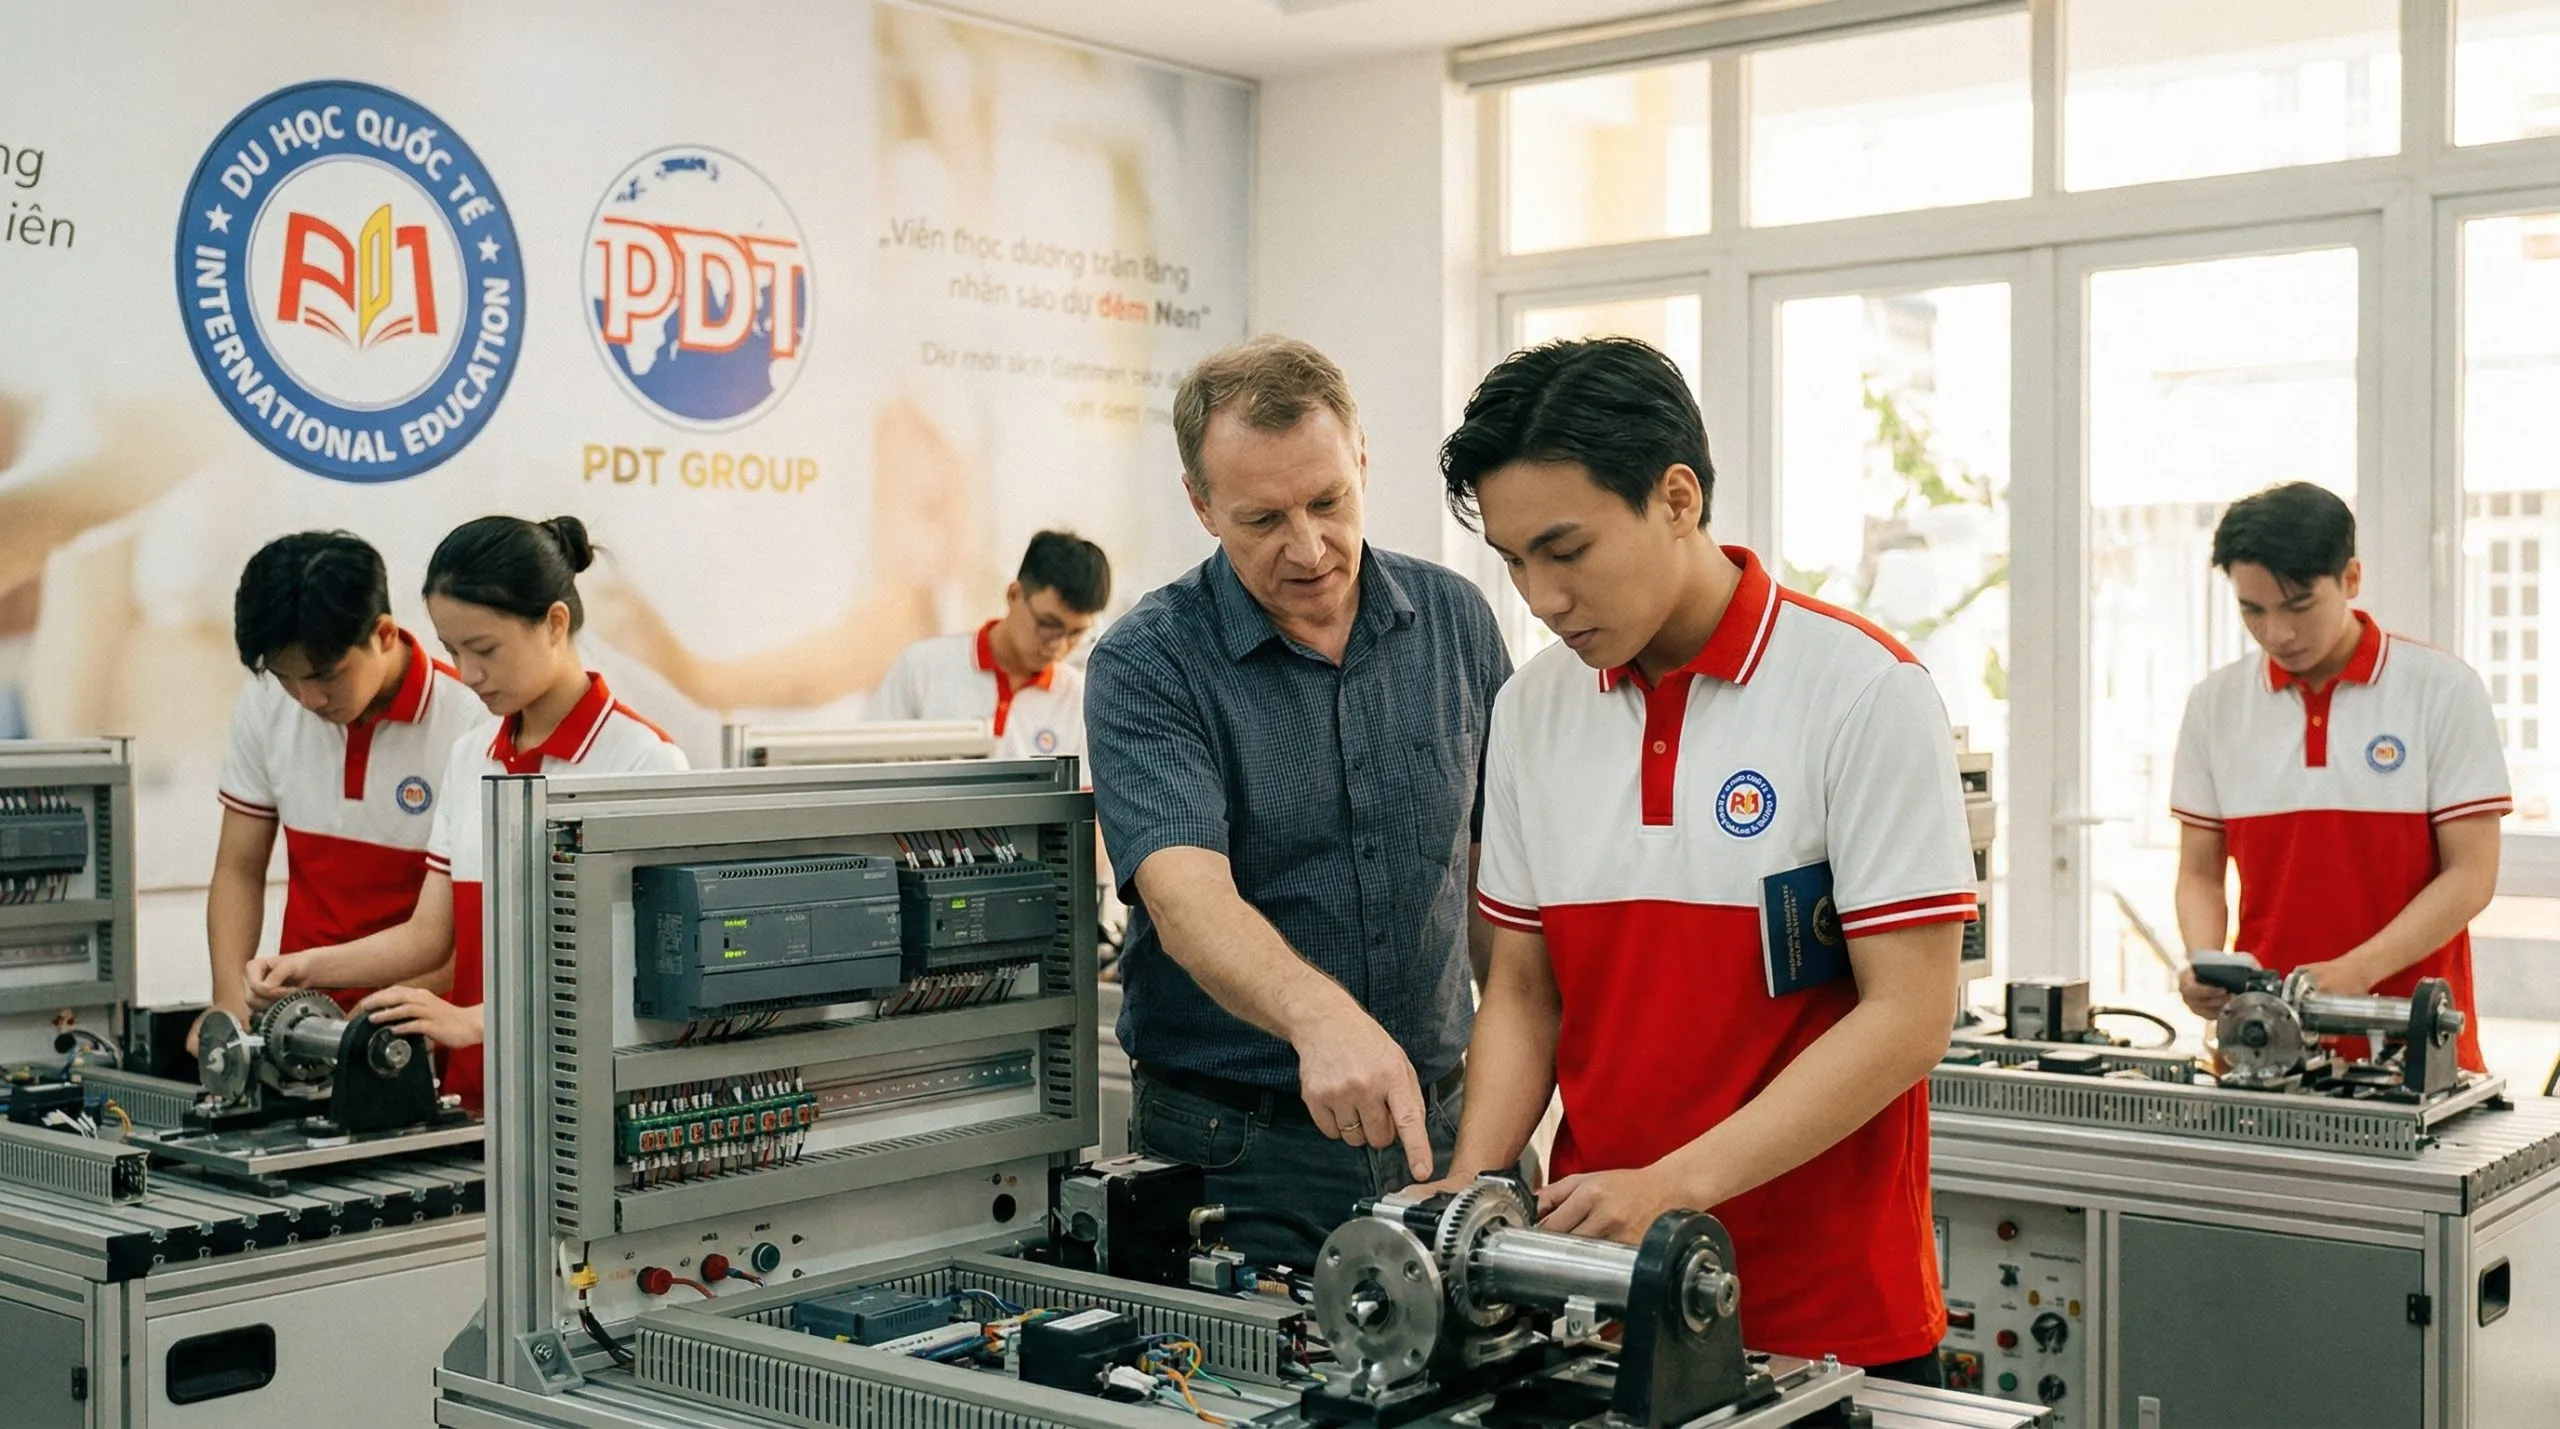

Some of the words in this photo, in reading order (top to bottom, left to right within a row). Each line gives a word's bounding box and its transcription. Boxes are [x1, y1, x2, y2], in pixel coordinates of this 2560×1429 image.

[220, 139, 270, 200] DU
[268, 105, 345, 156] HỌC
[356, 108, 452, 182] QUỐC
[448, 173, 496, 226] TẾ
[595, 216, 805, 358] PDT
[195, 245, 397, 463] INTERNATIONAL
[400, 277, 511, 456] EDUCATION
[583, 444, 666, 486] PDT
[679, 450, 819, 493] GROUP
